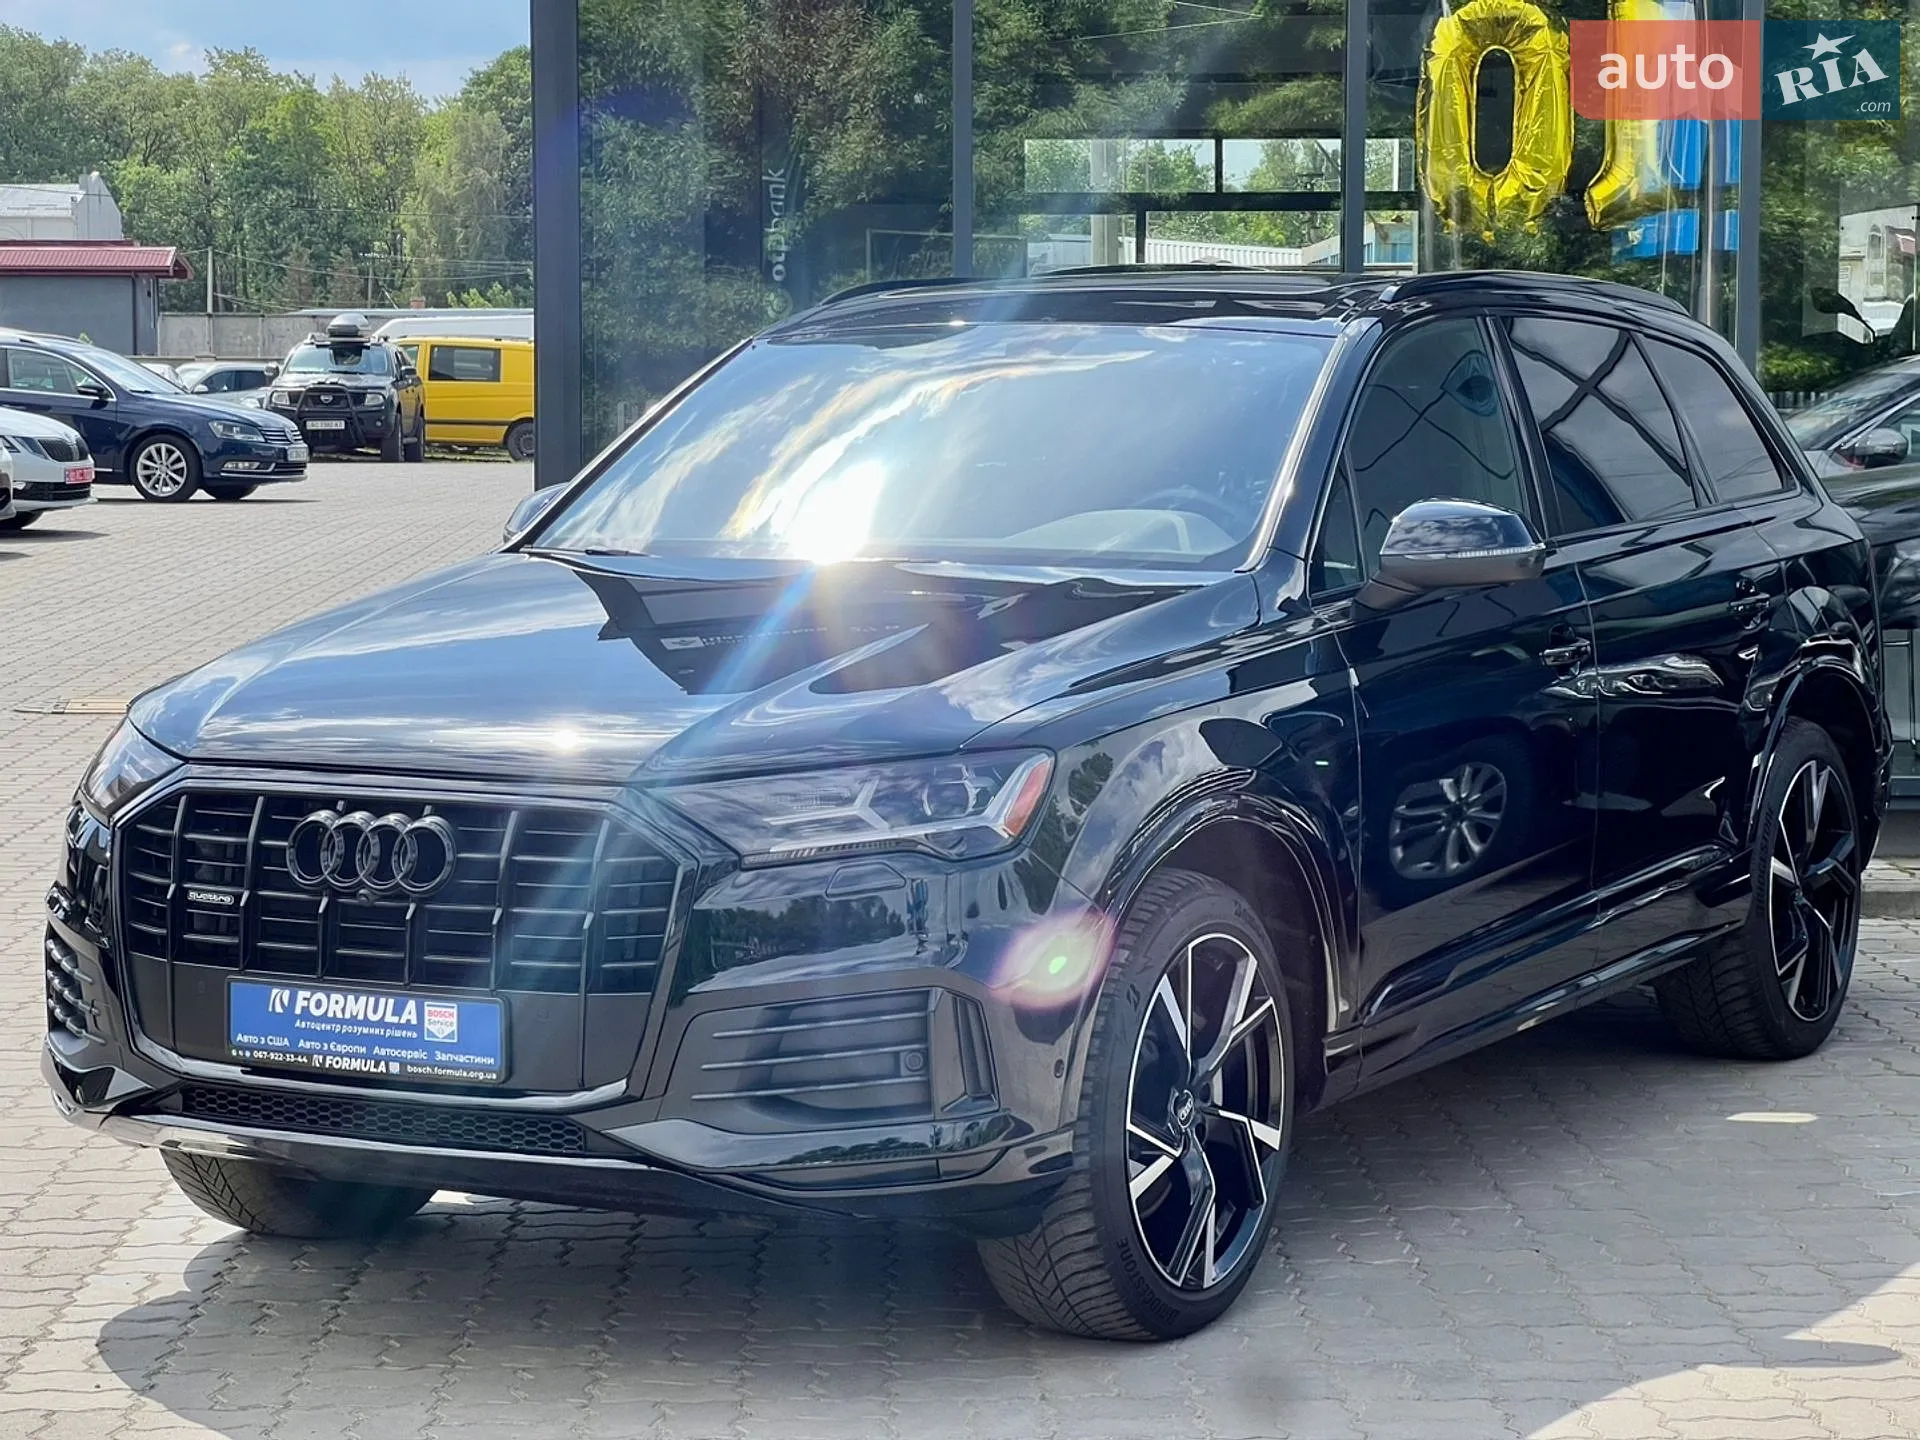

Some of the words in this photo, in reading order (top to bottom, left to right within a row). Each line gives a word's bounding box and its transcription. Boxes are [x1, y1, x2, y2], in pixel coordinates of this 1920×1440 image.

[294, 990, 418, 1025] FORMULA
[427, 1009, 455, 1020] BOSCH
[294, 1019, 342, 1033] Автоцентр
[386, 1027, 418, 1039] рішень
[427, 1019, 455, 1027] Service
[236, 1033, 258, 1044] Авто
[266, 1036, 290, 1047] США
[298, 1039, 321, 1050] Авто
[329, 1042, 367, 1054] Європи
[373, 1046, 428, 1060] Автосервіс
[434, 1051, 495, 1065] Запчастини
[325, 1056, 386, 1073] FORMULA
[406, 1065, 497, 1080] bosch.formula.org.ua
